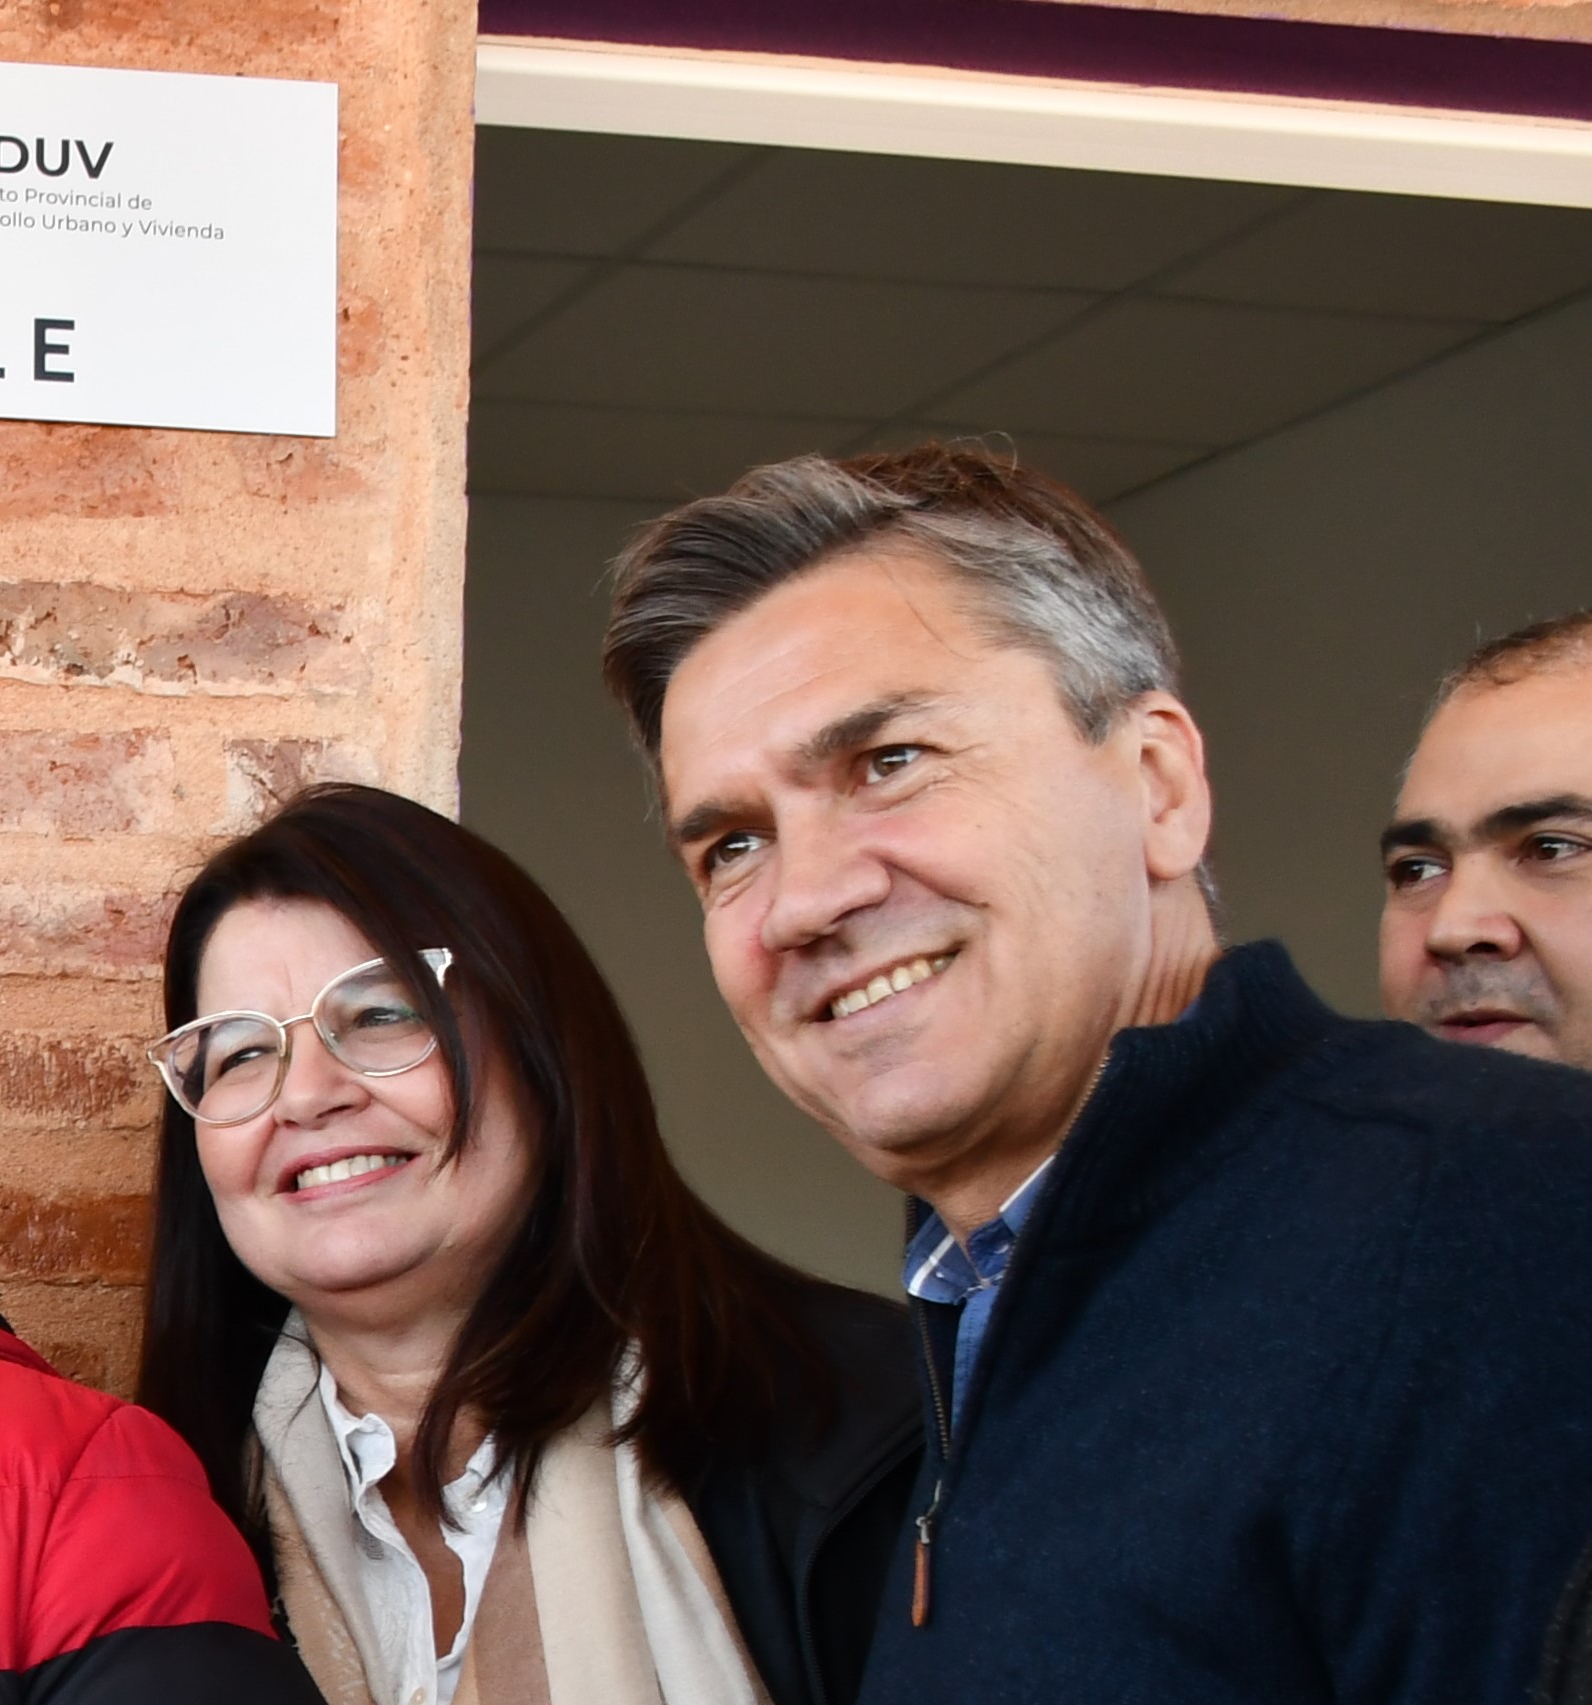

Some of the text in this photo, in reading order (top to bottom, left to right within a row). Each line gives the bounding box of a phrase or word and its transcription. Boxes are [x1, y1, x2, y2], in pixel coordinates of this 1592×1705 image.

[24, 188, 121, 211] Provincial
[127, 194, 153, 211] de
[42, 213, 117, 233] Urbano
[122, 221, 134, 238] y
[139, 220, 225, 241] Vivienda
[34, 318, 75, 383] E
